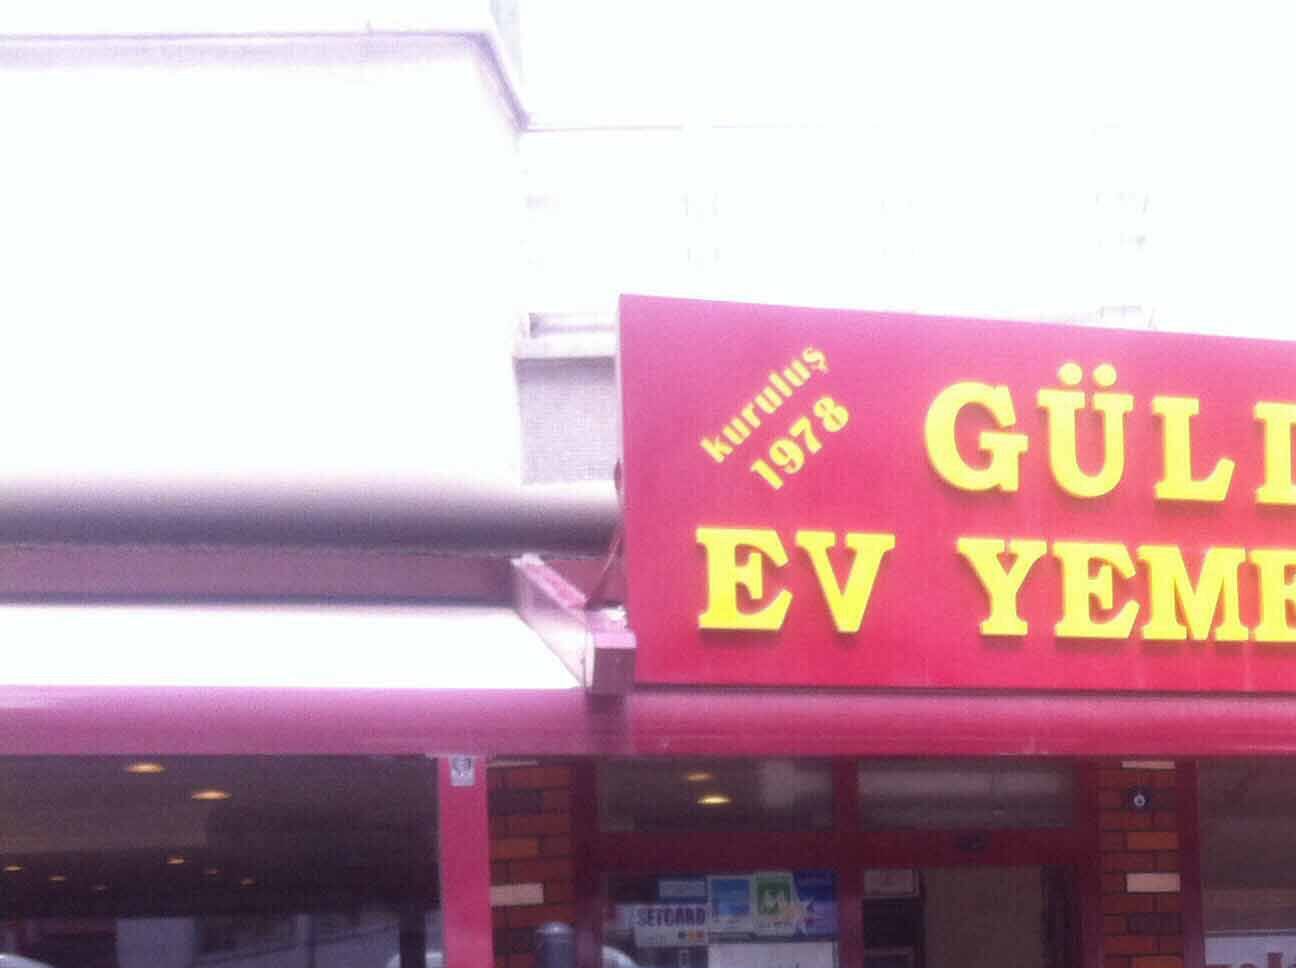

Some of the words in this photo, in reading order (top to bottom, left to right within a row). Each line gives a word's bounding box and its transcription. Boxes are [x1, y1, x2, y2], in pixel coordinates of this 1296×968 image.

[700, 344, 830, 464] kuruluş
[749, 395, 852, 491] 1978
[696, 526, 896, 634] EV
